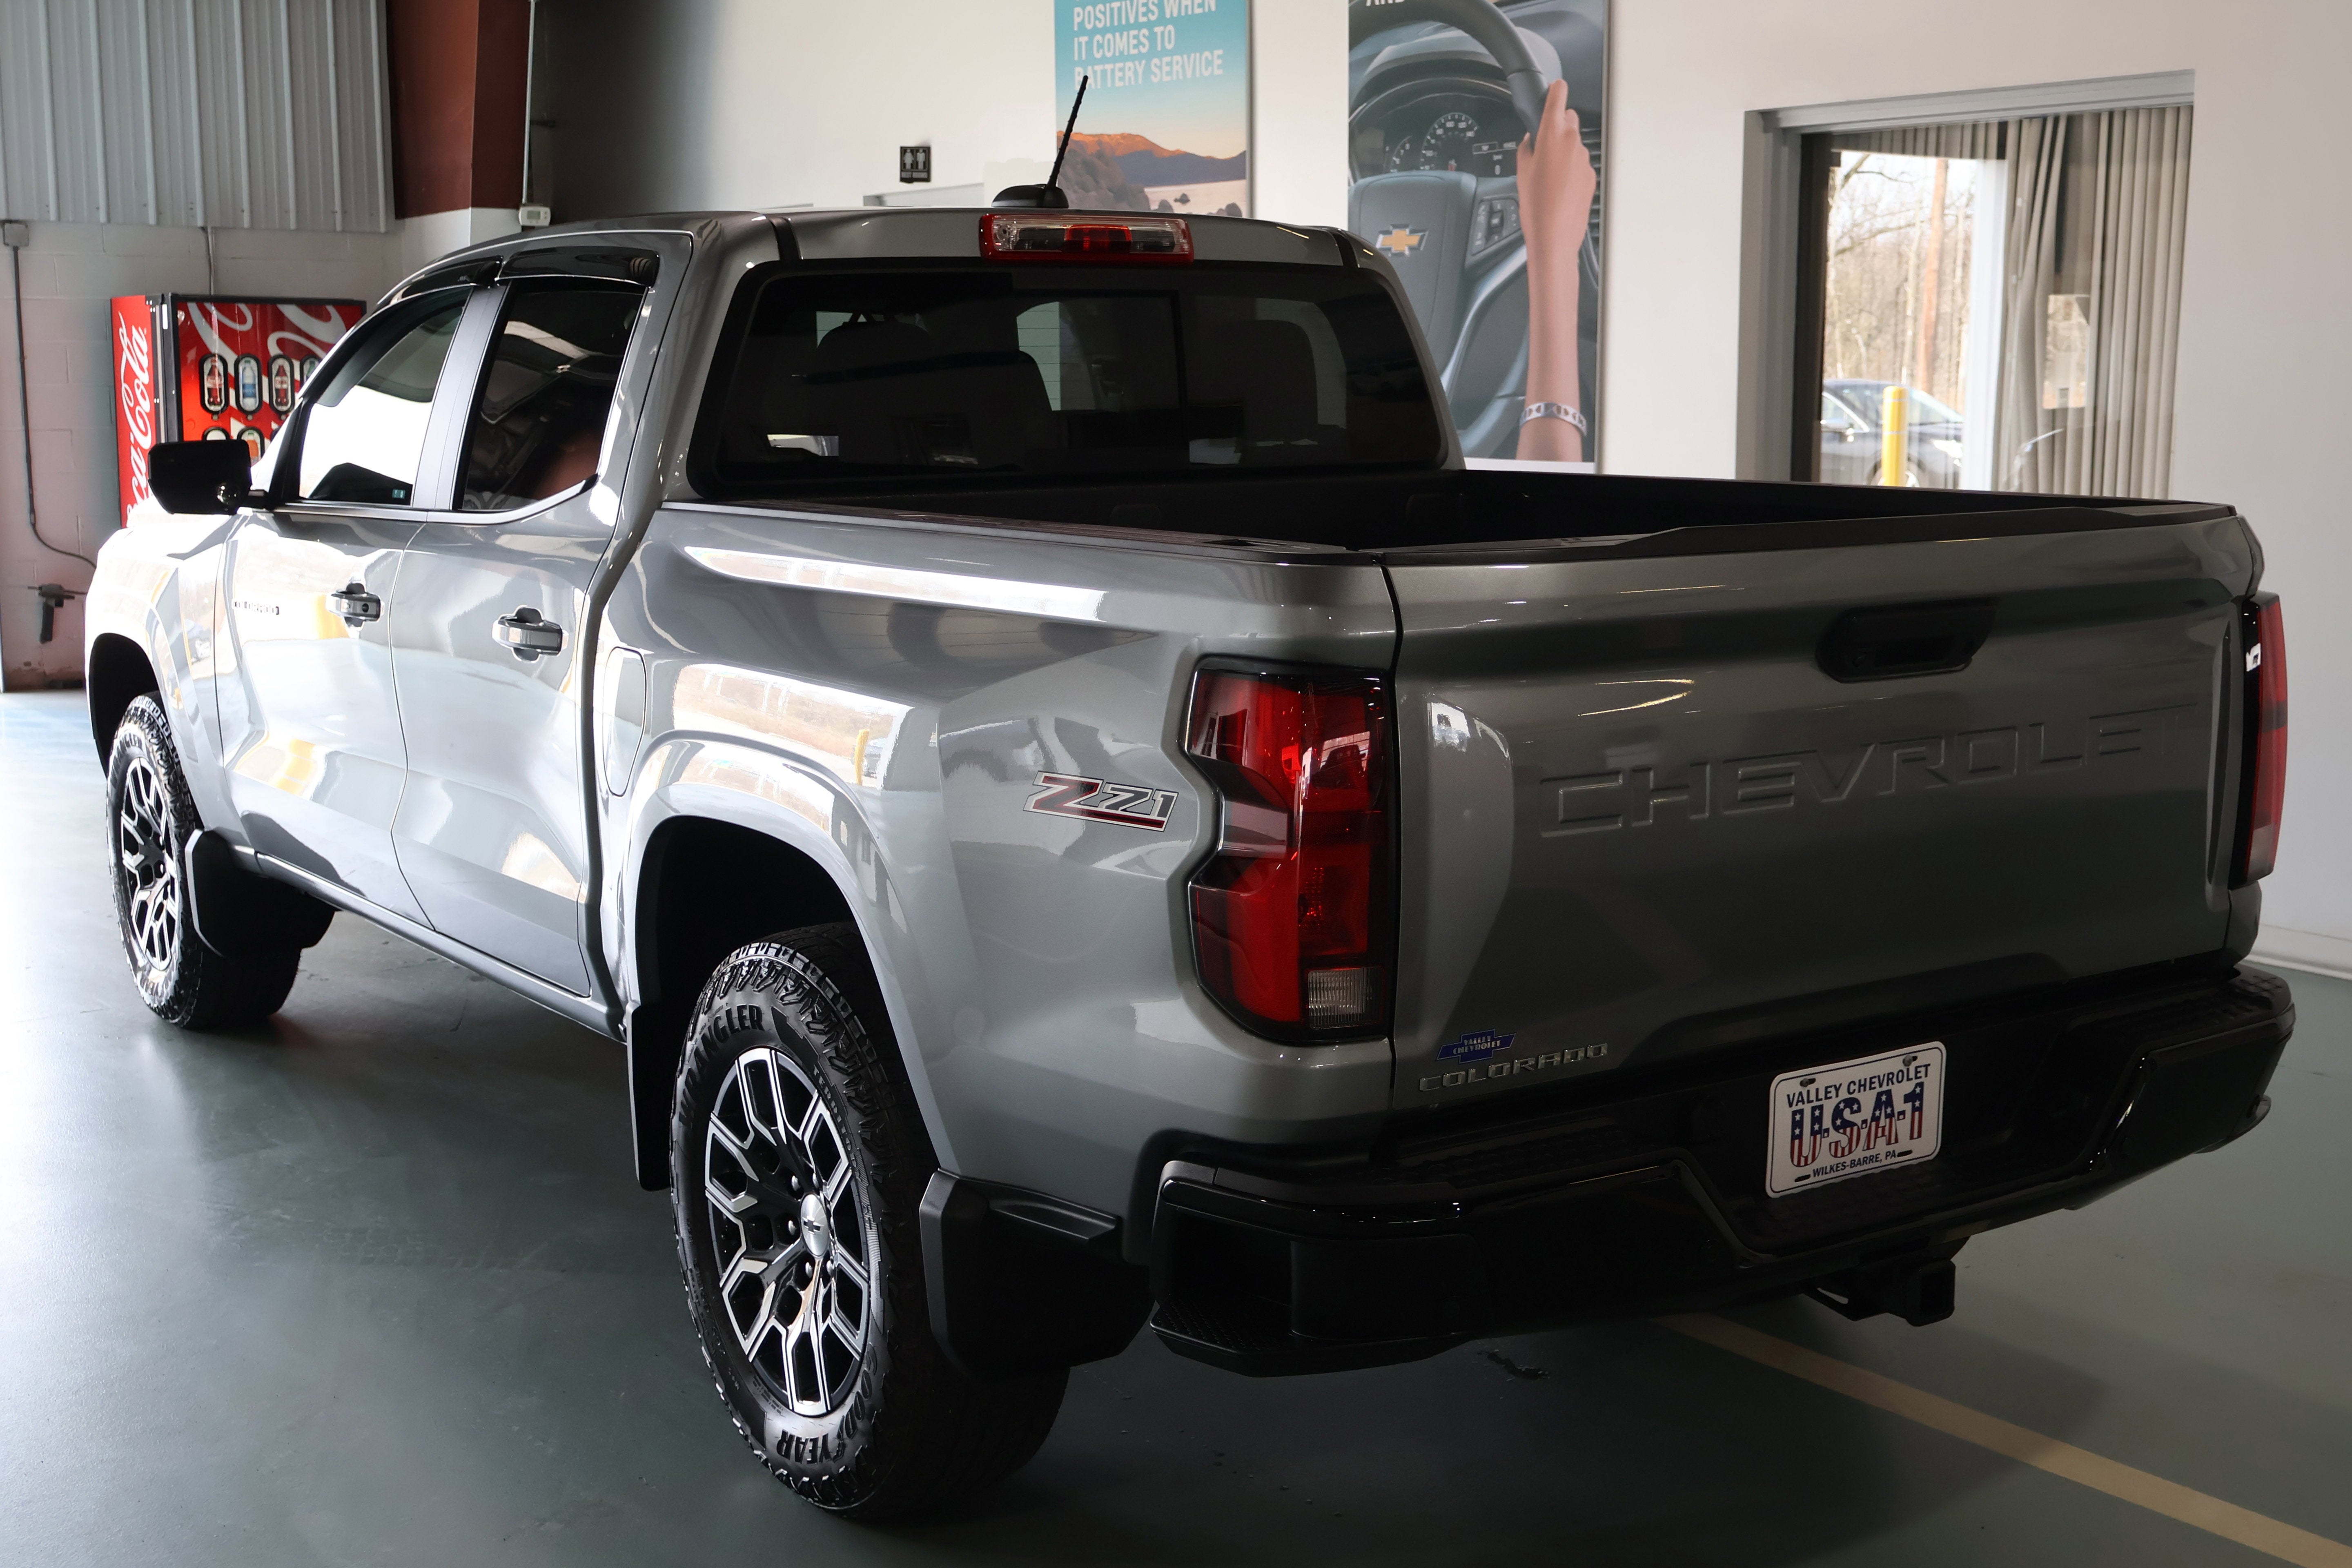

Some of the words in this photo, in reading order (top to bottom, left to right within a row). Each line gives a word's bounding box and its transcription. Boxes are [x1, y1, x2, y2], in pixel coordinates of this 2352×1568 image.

[1074, 0, 1159, 31] POSITIVES
[1074, 36, 1088, 60] IT
[1093, 29, 1149, 58] COMES
[1154, 24, 1175, 51] TO
[1074, 60, 1146, 90] BATTERY
[1150, 49, 1224, 83] SERVICE
[118, 311, 152, 513] ca-Cola
[1540, 703, 2198, 837] CHEVROLET
[1023, 770, 1179, 832] Z71
[1453, 1040, 1501, 1055] CHEVROLET
[1464, 1036, 1491, 1046] VALLEY
[1419, 1043, 1608, 1091] COLORADO
[1787, 1083, 1842, 1108] VALLEY
[1847, 1064, 1931, 1095] CHEVROLET
